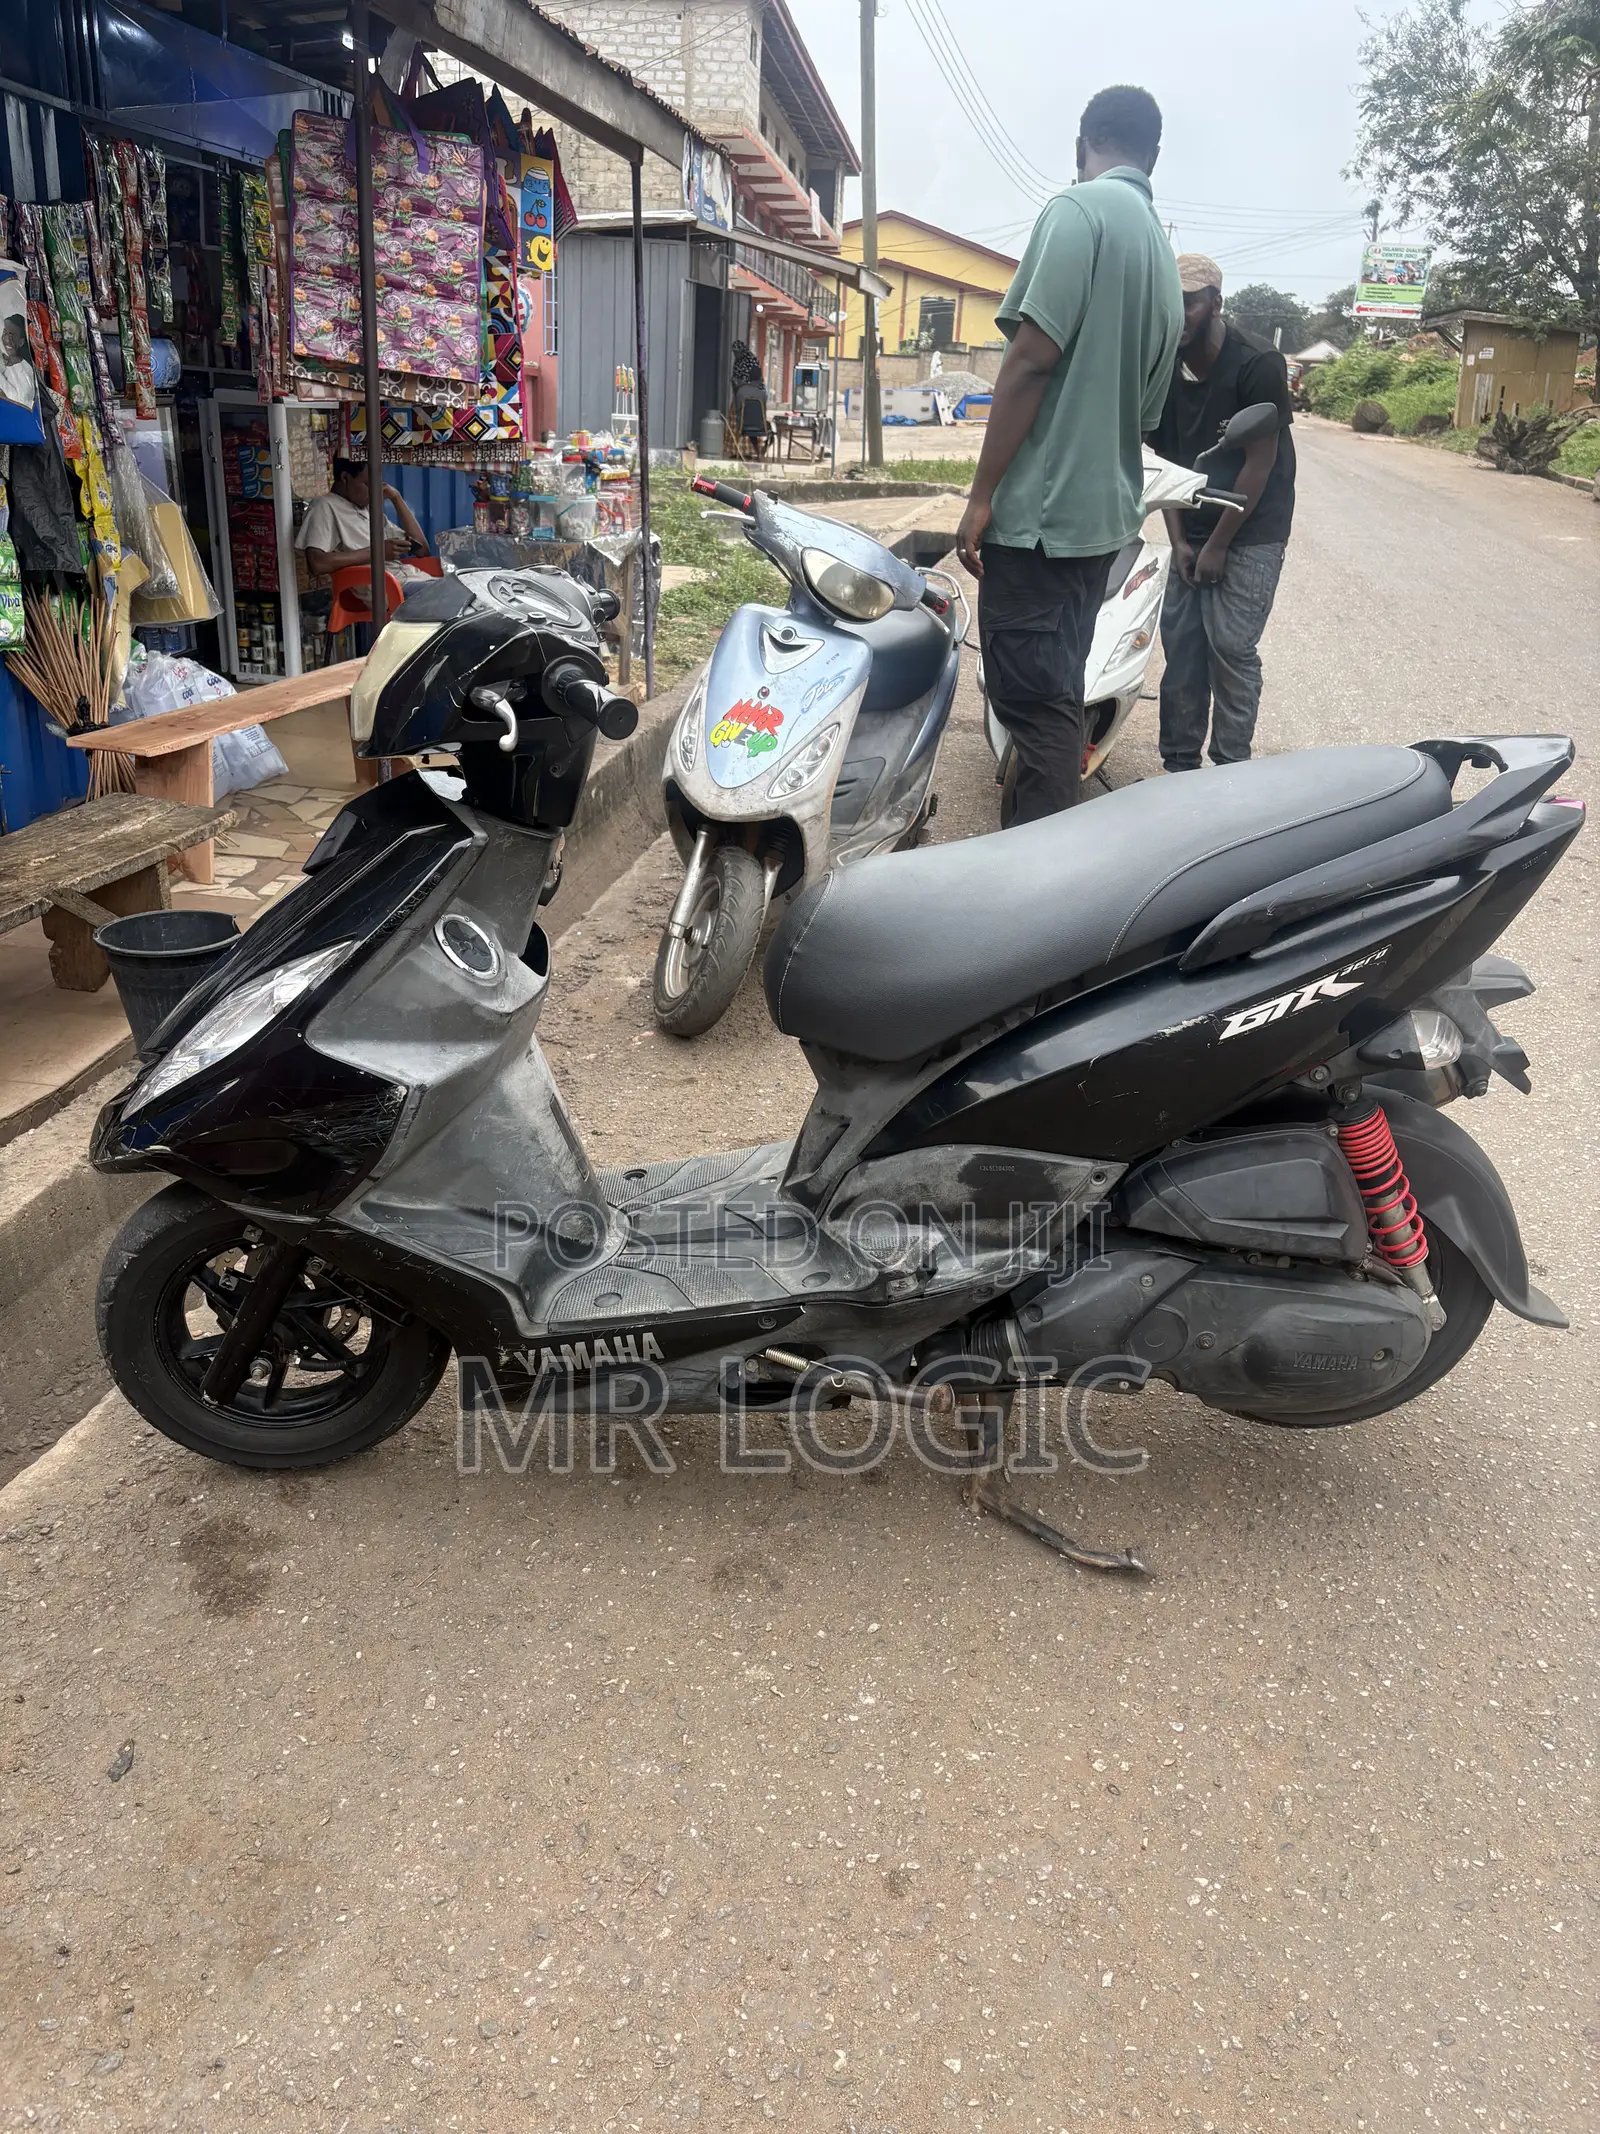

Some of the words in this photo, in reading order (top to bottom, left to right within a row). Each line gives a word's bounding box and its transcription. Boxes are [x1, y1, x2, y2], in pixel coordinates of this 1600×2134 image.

[722, 698, 784, 736] NEVER
[746, 731, 779, 759] UP
[513, 1331, 665, 1377] YAMAHA
[1293, 1352, 1360, 1371] YAMAHA
